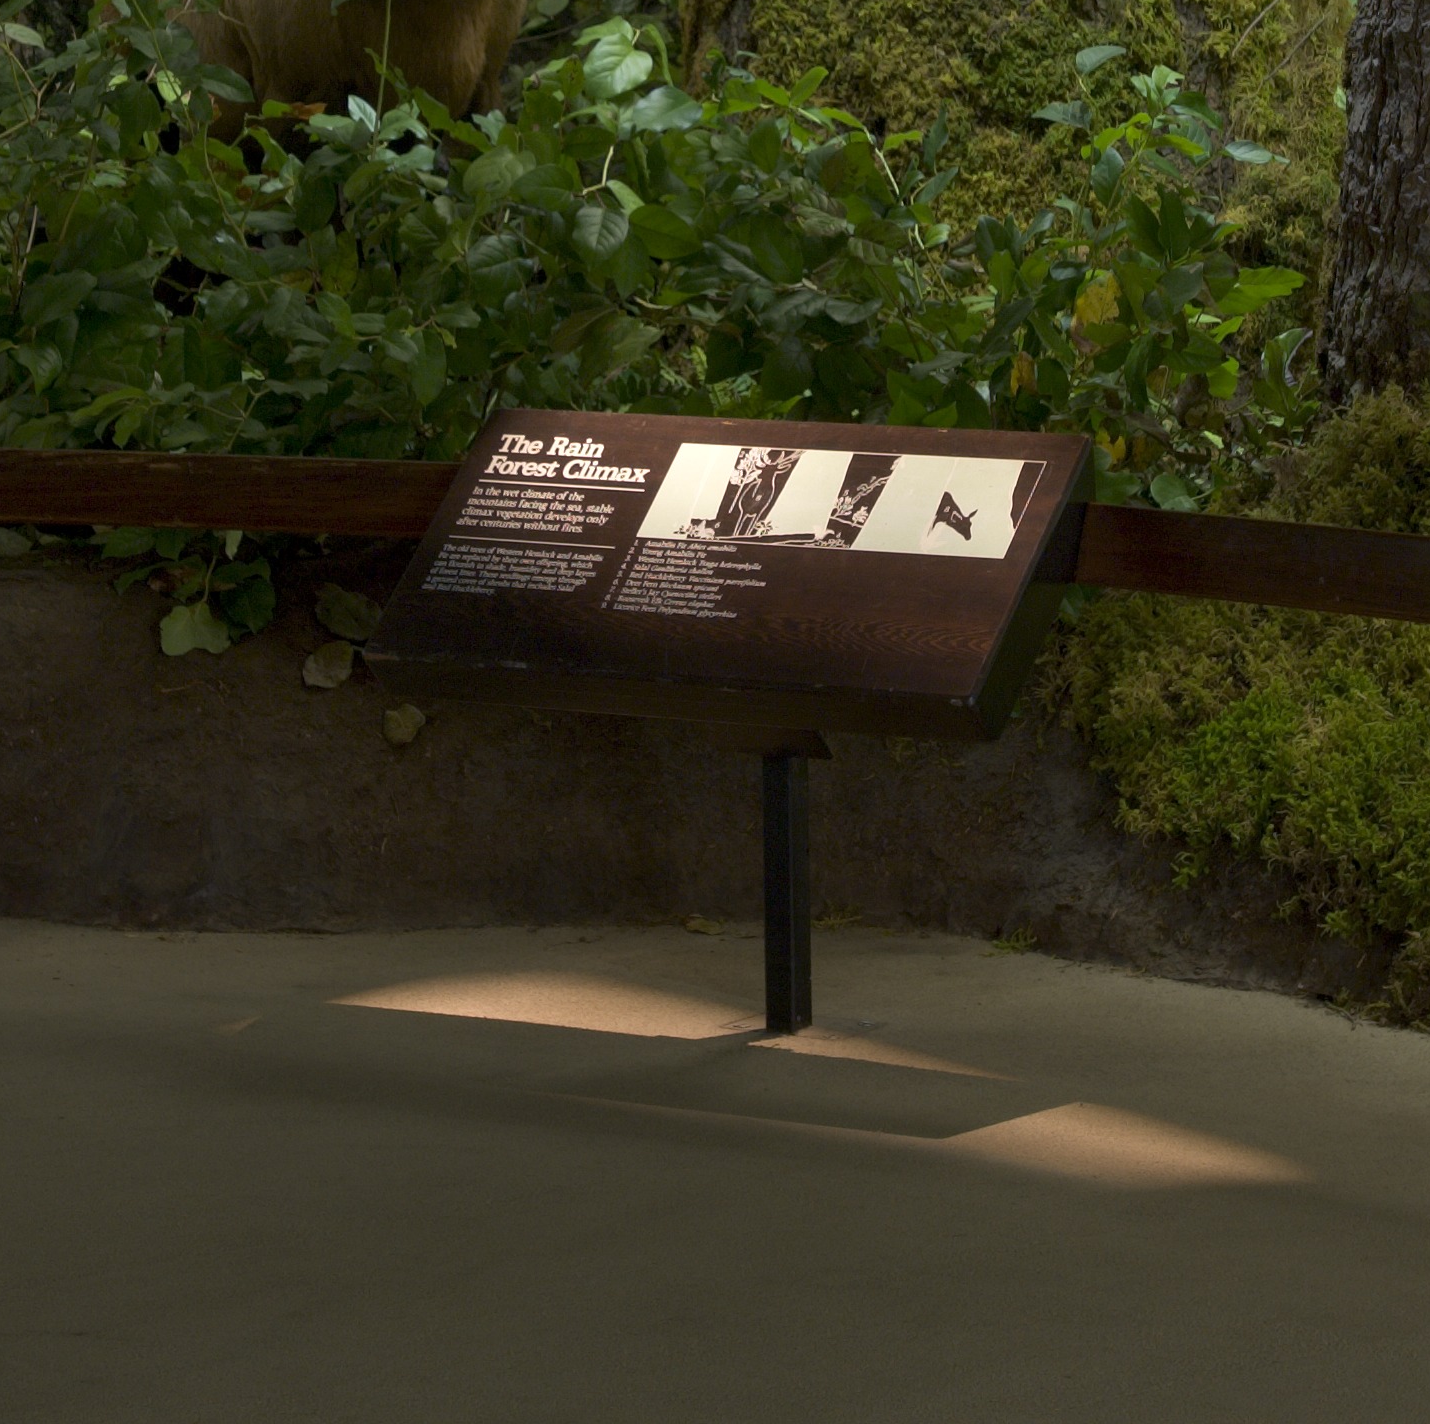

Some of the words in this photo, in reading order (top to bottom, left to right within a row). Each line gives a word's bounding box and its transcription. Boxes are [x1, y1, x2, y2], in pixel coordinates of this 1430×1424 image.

[499, 434, 544, 455] The
[546, 436, 605, 458] Rain
[485, 455, 560, 478] Forest
[562, 459, 650, 483] Climax
[472, 486, 484, 495] In
[485, 487, 502, 496] the
[502, 489, 520, 498] wet
[520, 488, 556, 500] climate
[555, 490, 570, 501] of
[568, 491, 585, 502] the
[467, 498, 518, 508] mountains
[518, 499, 549, 513] facing
[549, 500, 566, 511] the
[566, 504, 583, 515] sea,
[585, 503, 615, 514] stable
[456, 516, 479, 526] after
[480, 517, 522, 529] centuries
[523, 520, 561, 532] without
[560, 522, 583, 533] fires.
[462, 507, 494, 516] climax
[496, 509, 545, 523] vegetation
[540, 511, 586, 526] develops
[585, 514, 609, 526] only
